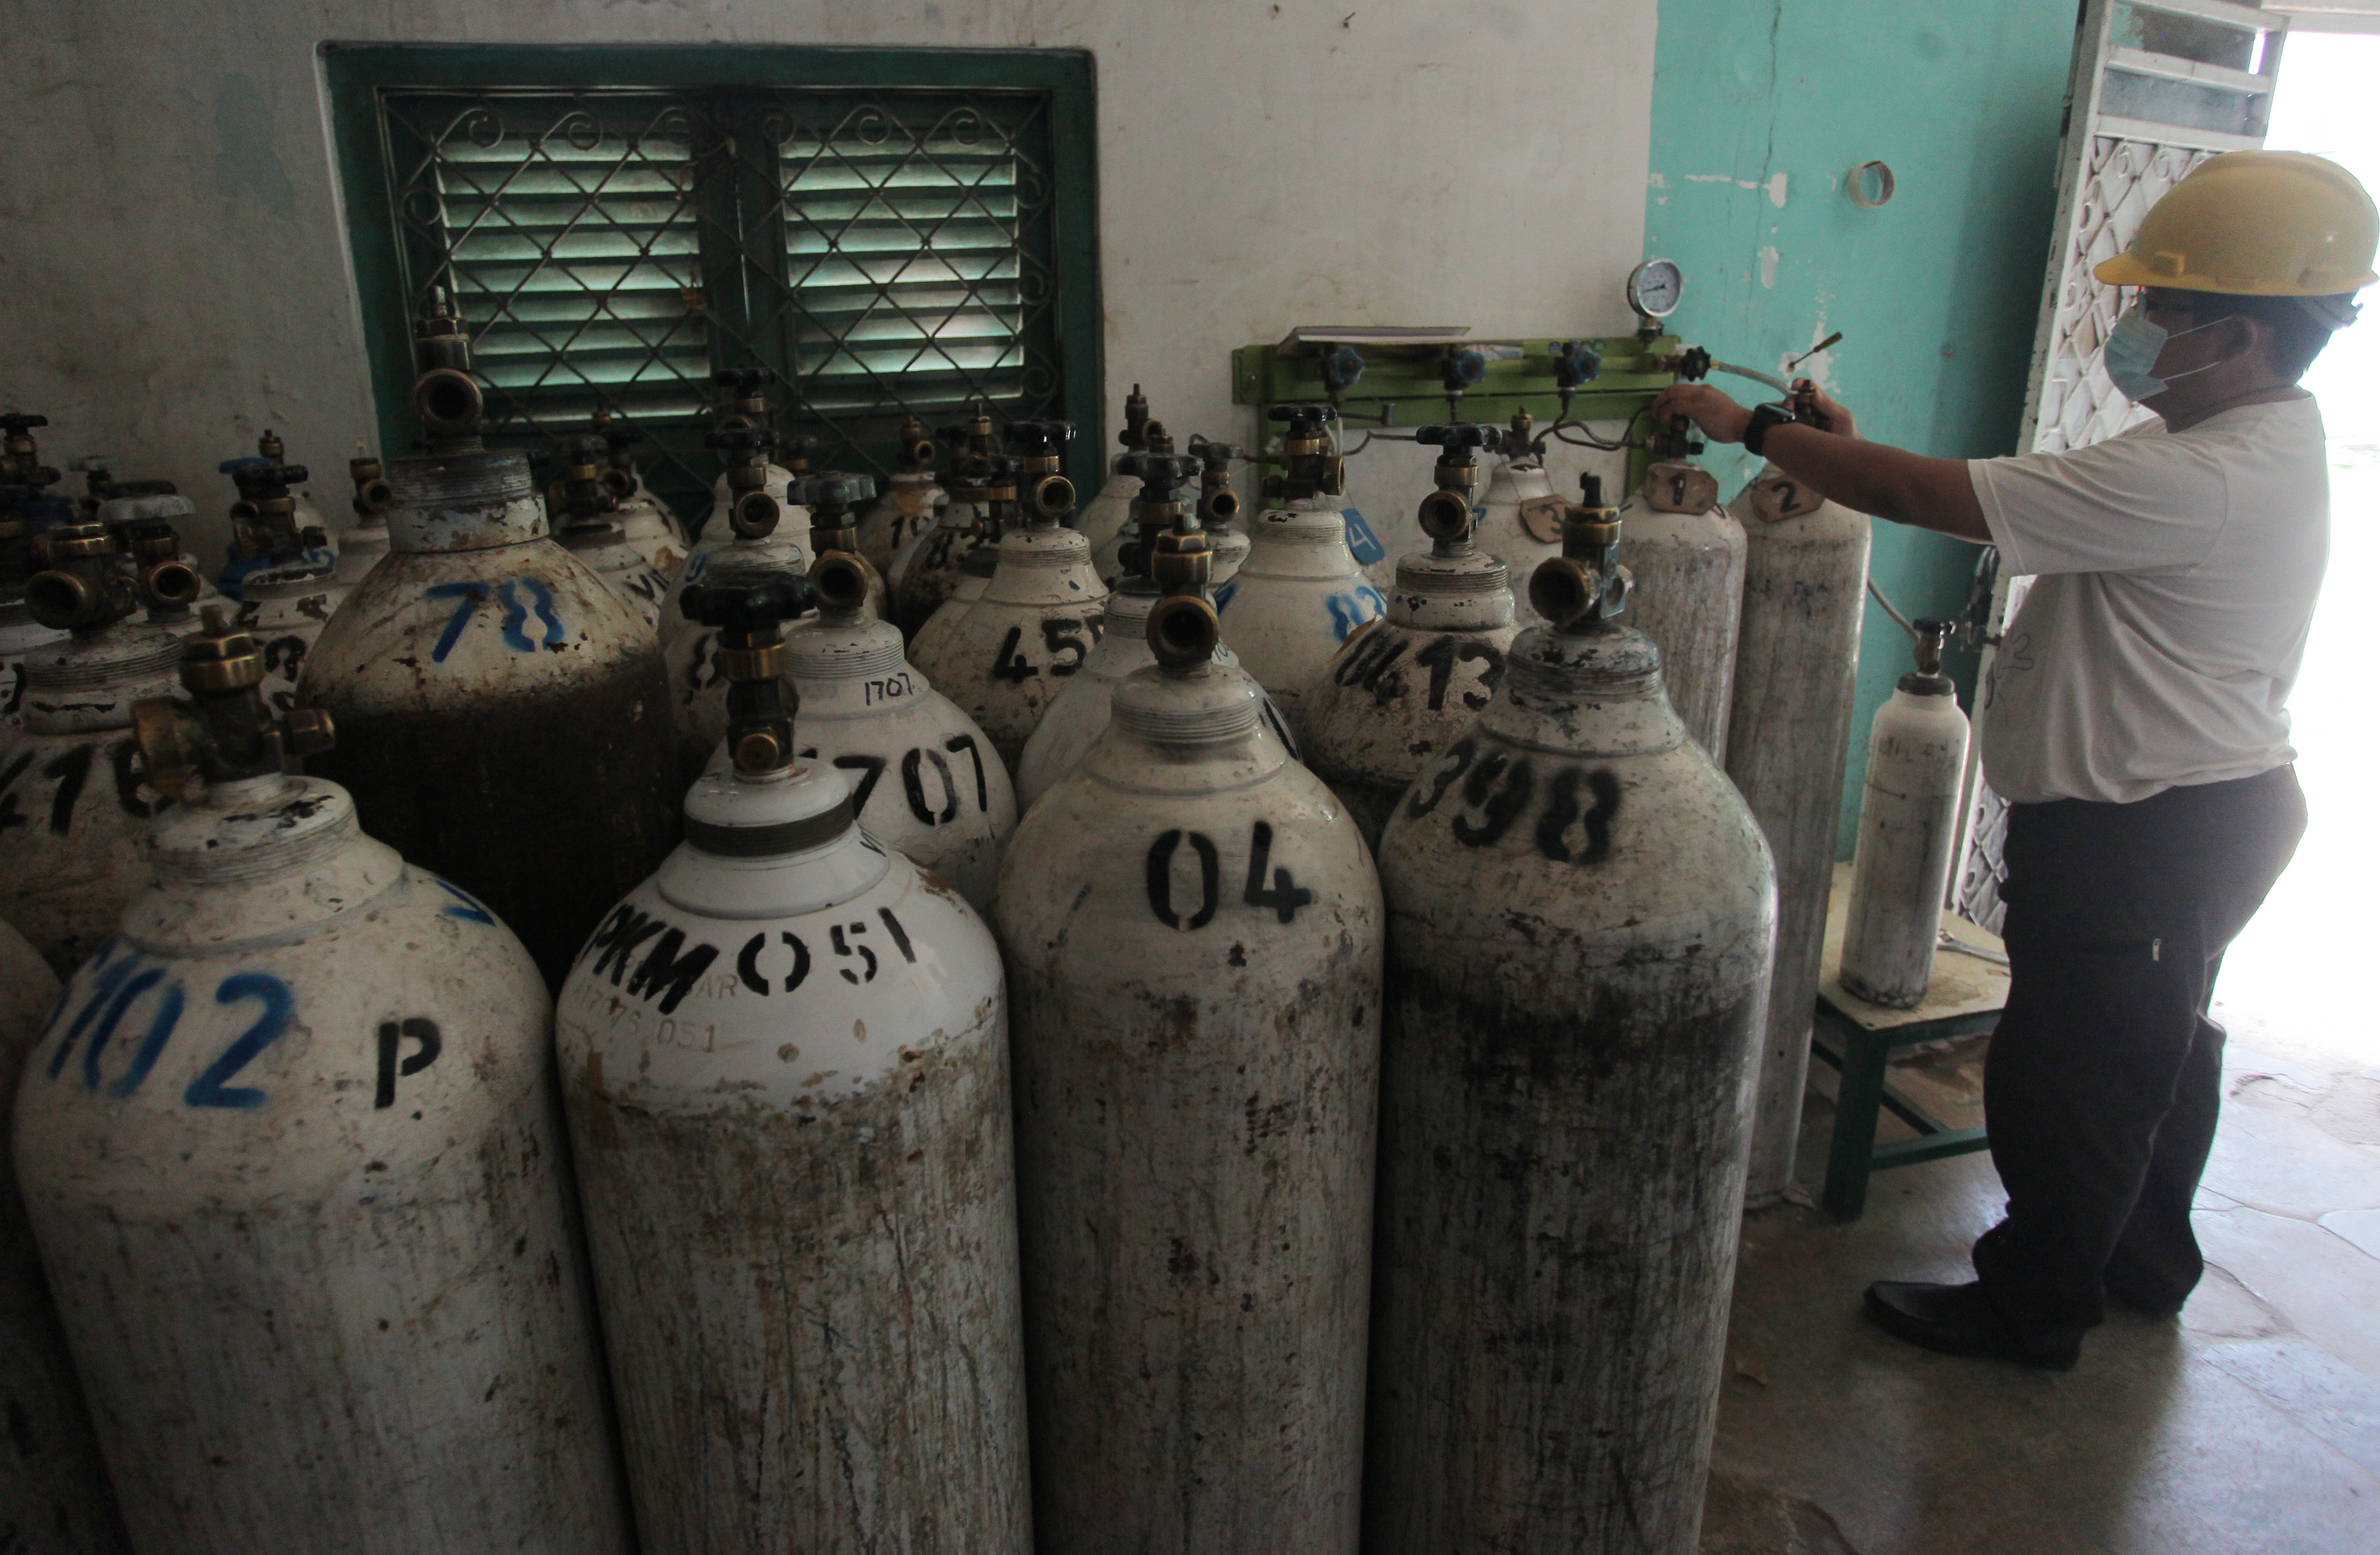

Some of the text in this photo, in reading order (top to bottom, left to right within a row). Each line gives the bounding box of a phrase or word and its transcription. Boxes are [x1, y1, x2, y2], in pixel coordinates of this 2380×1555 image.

[1670, 473, 1687, 506] 1
[1771, 481, 1801, 513] 2
[1349, 523, 1376, 550] 4
[422, 575, 566, 663] 78
[863, 672, 914, 707] 1707
[1145, 820, 1313, 932] 04
[375, 1017, 442, 1110] P
